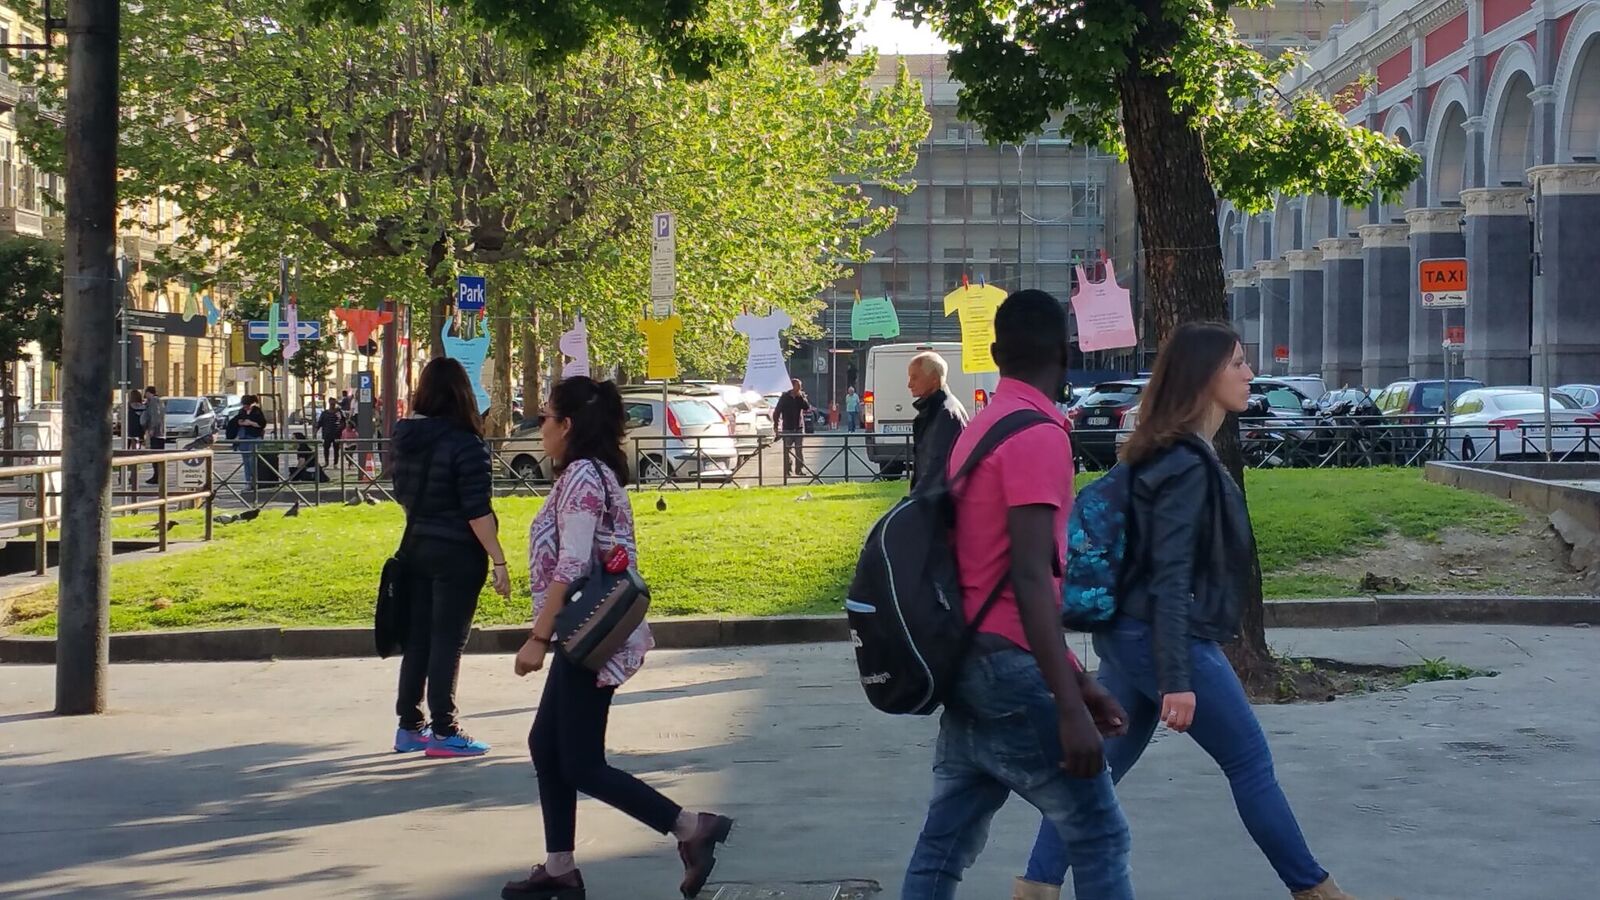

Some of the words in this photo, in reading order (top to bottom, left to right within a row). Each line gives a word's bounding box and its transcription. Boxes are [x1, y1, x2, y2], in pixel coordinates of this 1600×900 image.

[660, 217, 668, 235] P
[1425, 269, 1464, 283] TAXI
[459, 283, 484, 303] Park
[361, 375, 370, 388] P
